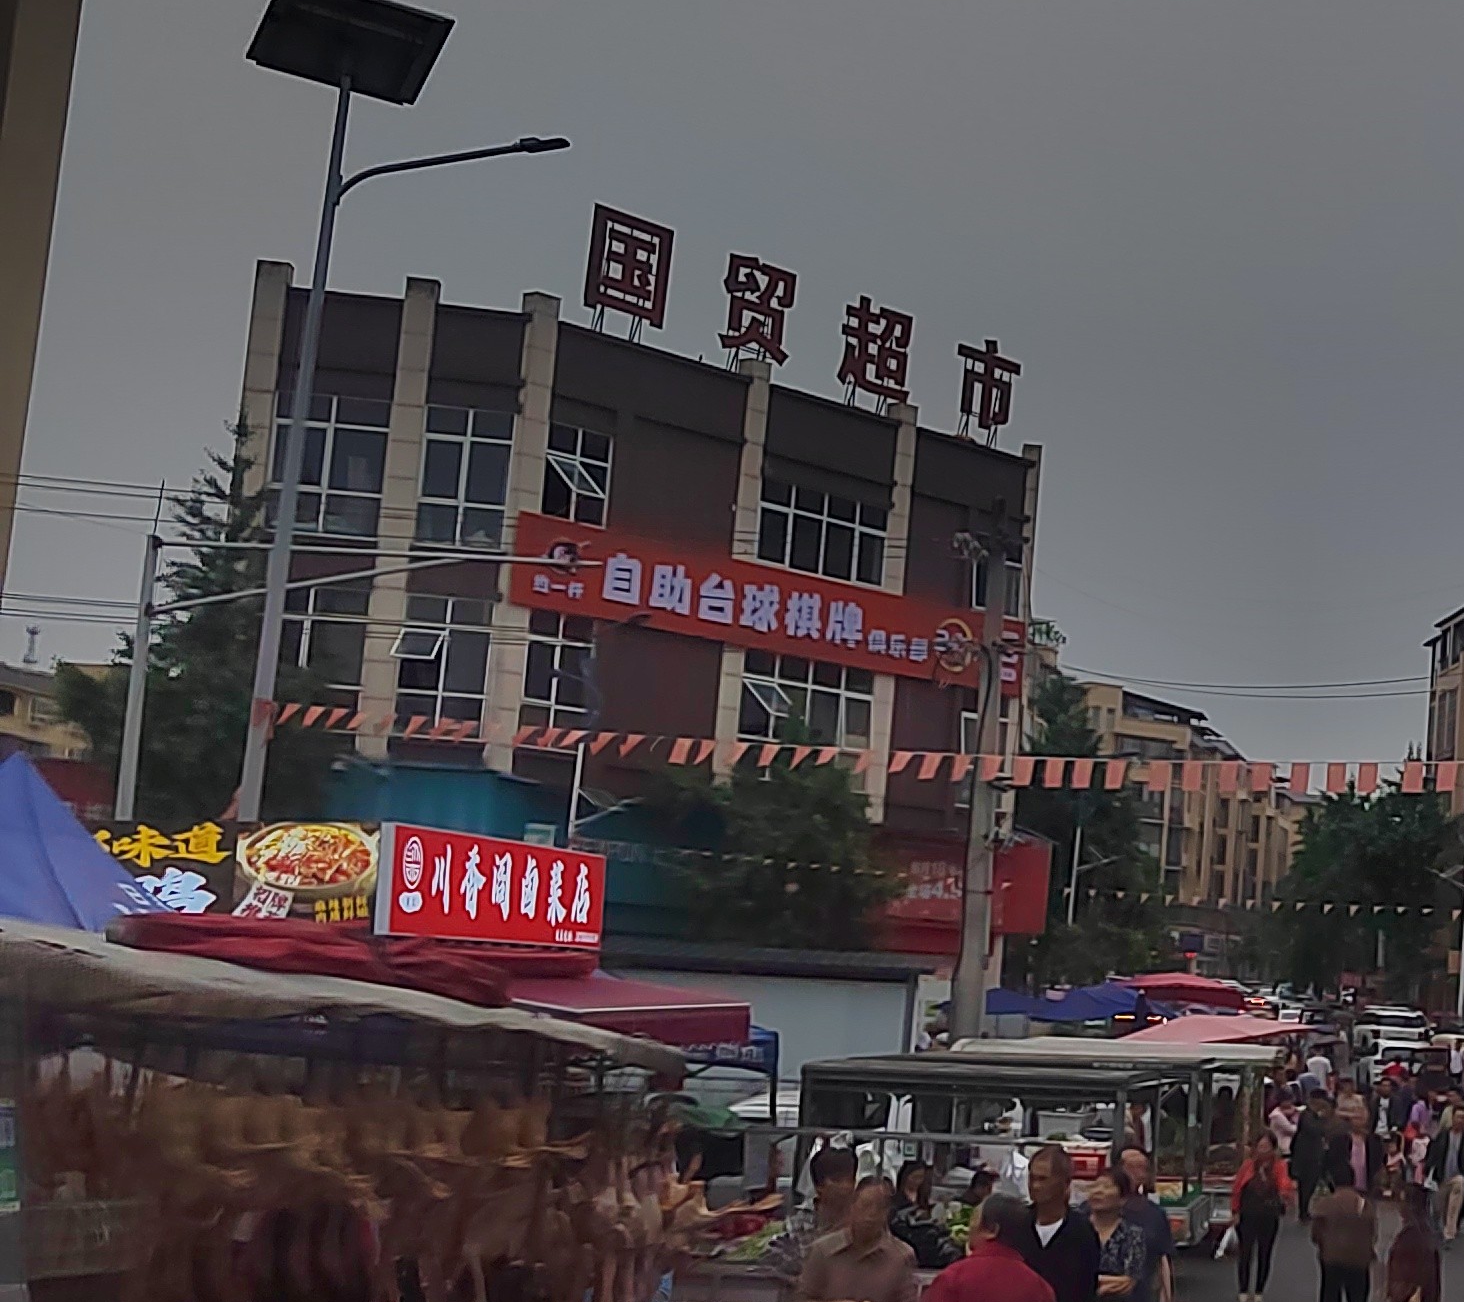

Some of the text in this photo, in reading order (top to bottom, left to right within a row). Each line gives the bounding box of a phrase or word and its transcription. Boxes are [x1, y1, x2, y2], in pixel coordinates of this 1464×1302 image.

[583, 202, 1022, 430] 国贸超市
[602, 552, 863, 648] 自助台球棋牌
[431, 843, 592, 928] 川香阁卤菜店
